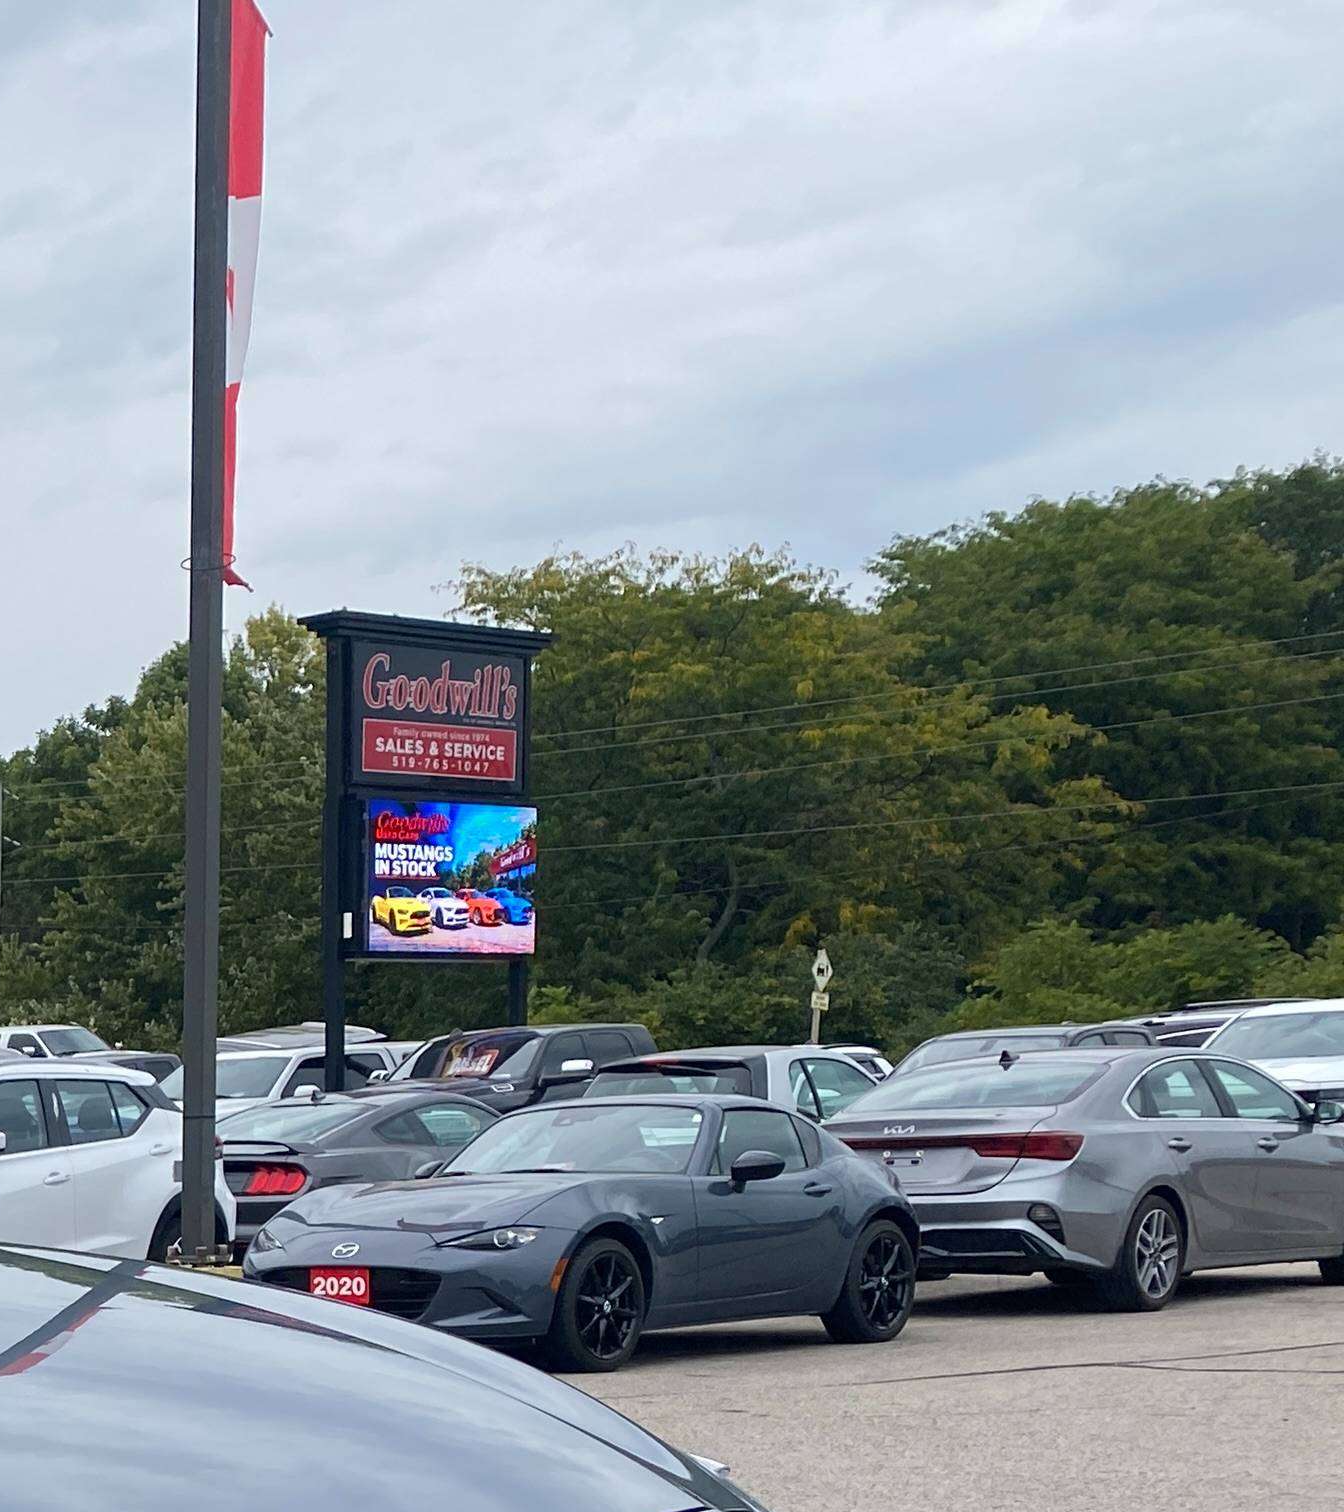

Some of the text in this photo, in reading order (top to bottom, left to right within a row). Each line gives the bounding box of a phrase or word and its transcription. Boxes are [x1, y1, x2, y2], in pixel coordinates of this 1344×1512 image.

[363, 653, 517, 720] Goodwill's
[375, 737, 505, 761] SALES & SERVICE
[392, 756, 489, 773] 519-765-1047
[375, 843, 454, 862] MUSTANGS
[375, 859, 436, 876] IN STOCK
[313, 1276, 366, 1297] 2020
